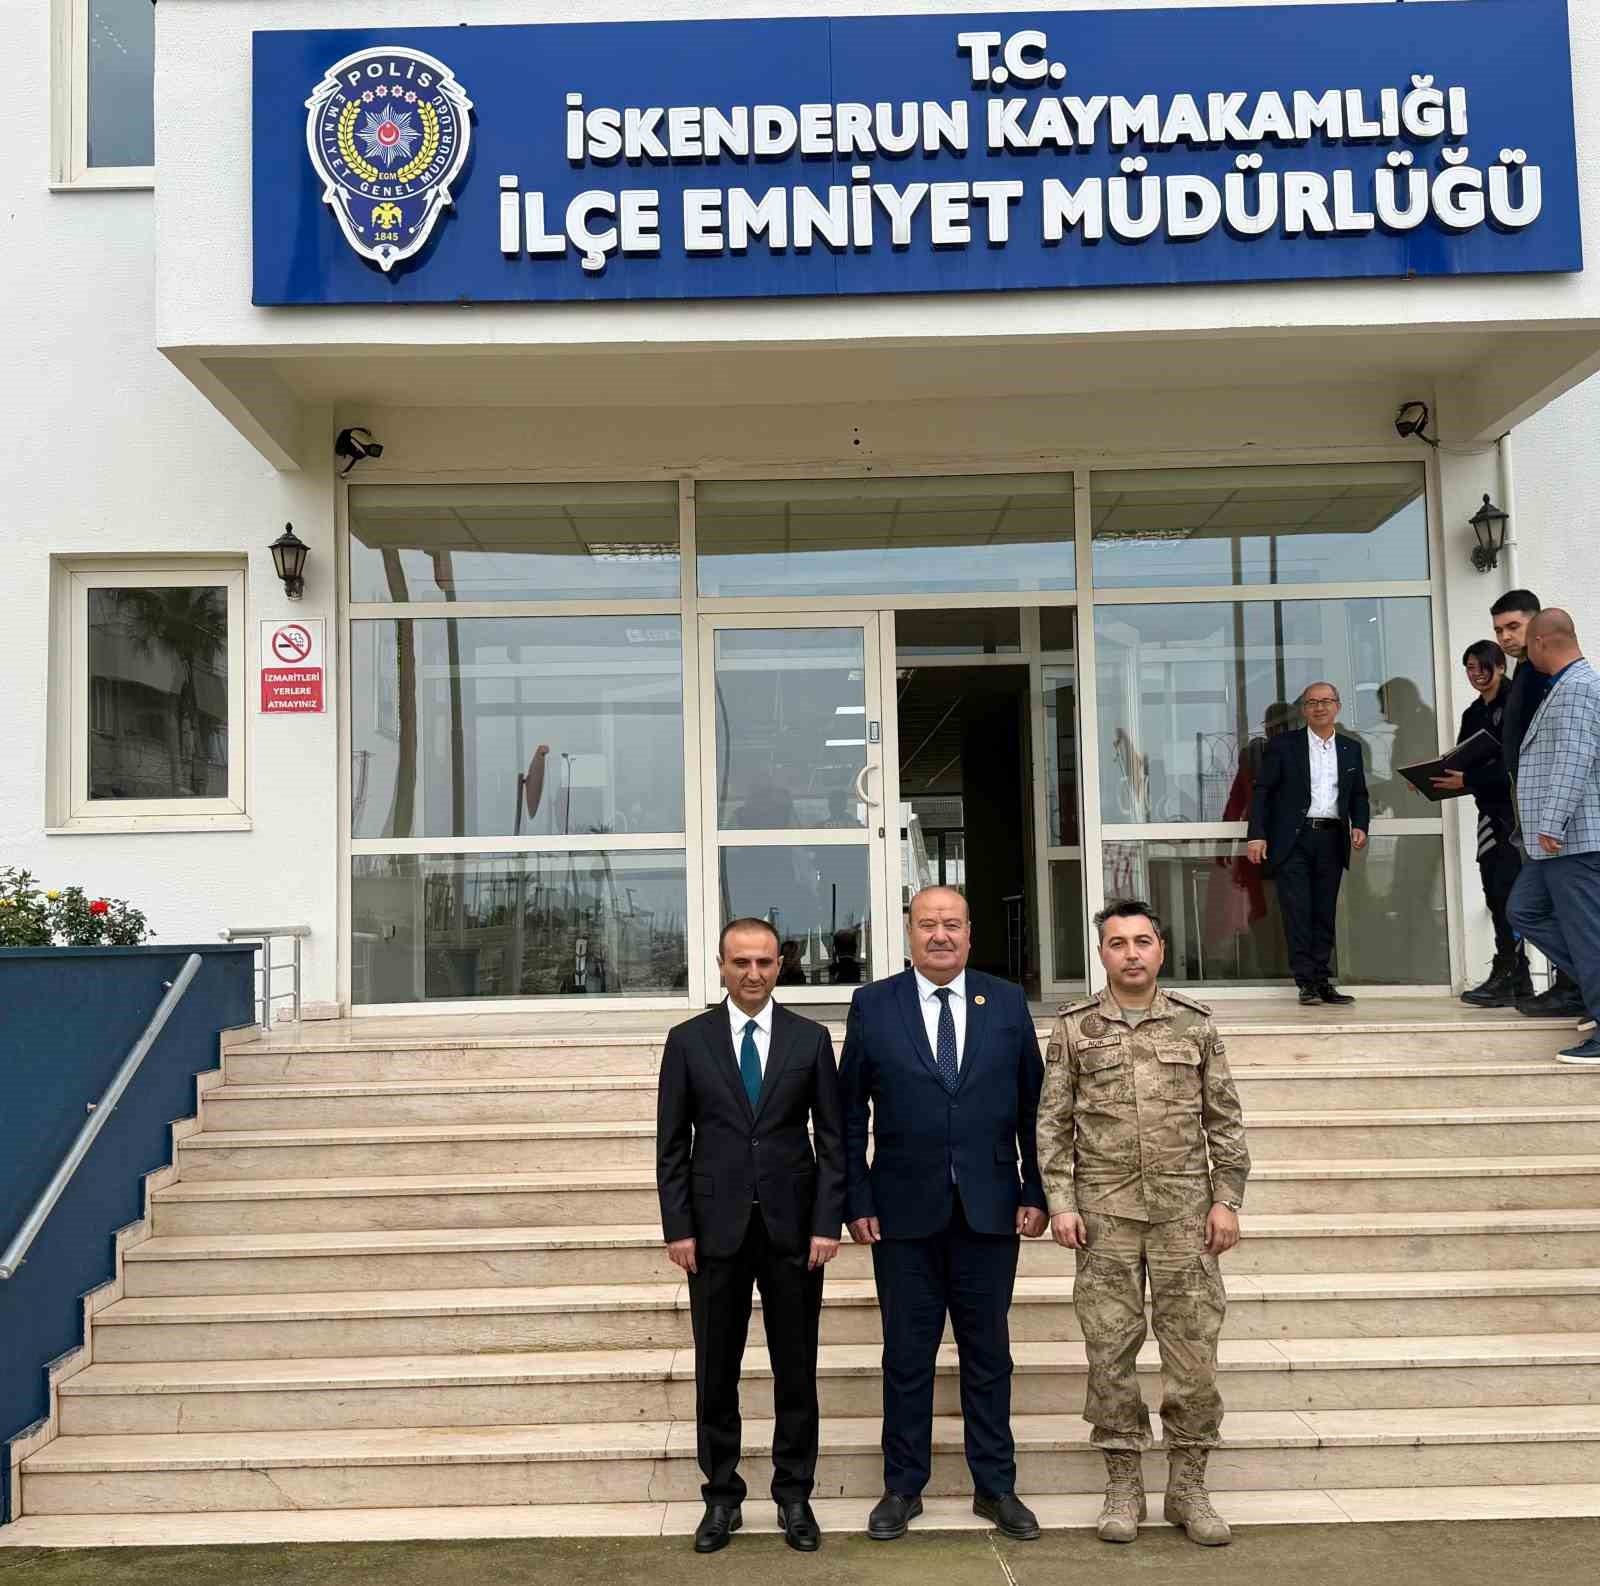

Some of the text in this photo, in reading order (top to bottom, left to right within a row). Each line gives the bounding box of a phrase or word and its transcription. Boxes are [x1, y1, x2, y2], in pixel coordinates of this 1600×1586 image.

[957, 30, 1066, 84] T.C.
[348, 62, 433, 87] POLİS
[566, 75, 1468, 160] İSKENDERUN KAYMAKAMLIĞI
[379, 172, 397, 181] EGM
[360, 183, 415, 196] GENEL
[499, 146, 1542, 270] İLÇE EMNİYET MÜDÜRLÜĞÜ
[374, 232, 399, 241] 1845
[264, 672, 320, 682] İZMARİTLERİ
[273, 687, 312, 695] YERLERE
[268, 700, 317, 708] ATMAYINIZ
